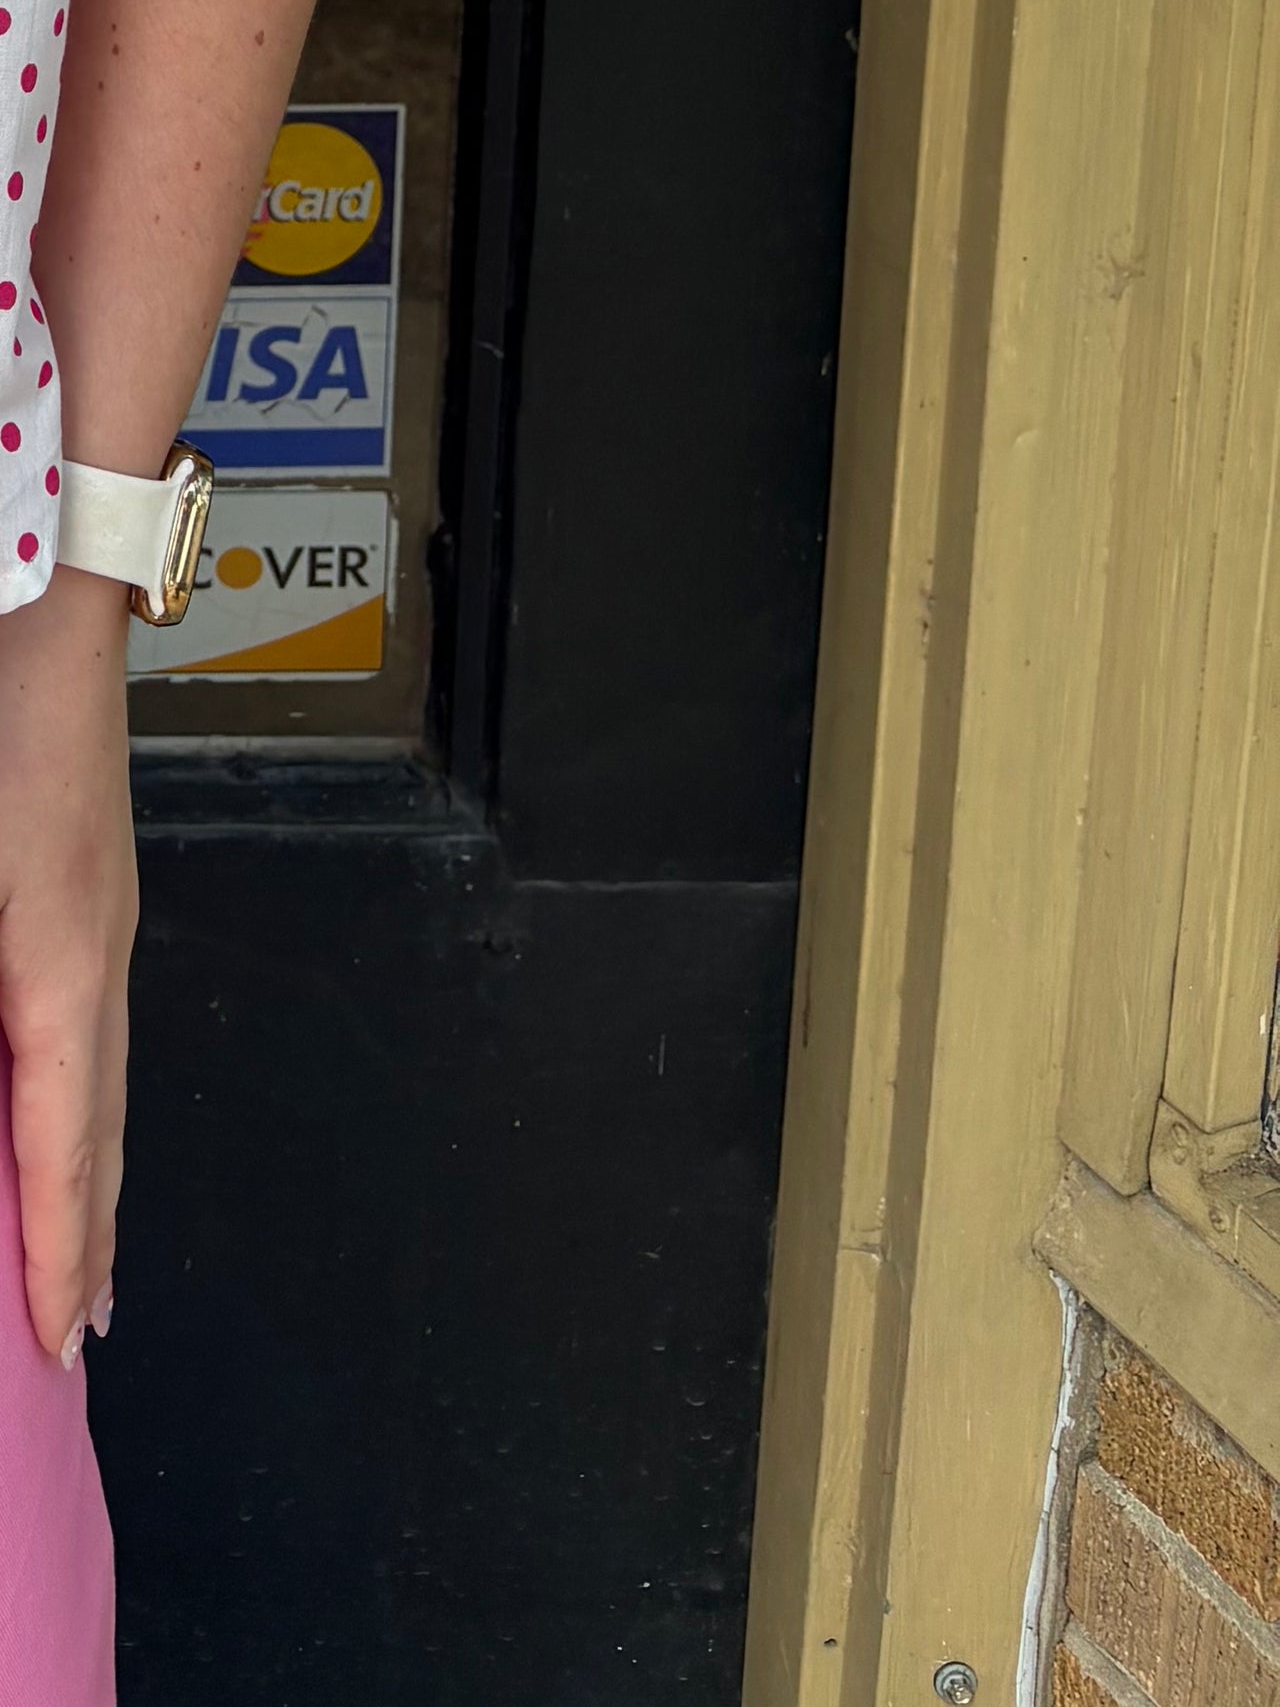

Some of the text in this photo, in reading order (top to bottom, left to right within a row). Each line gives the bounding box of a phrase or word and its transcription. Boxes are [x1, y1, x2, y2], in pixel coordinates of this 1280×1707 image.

[252, 179, 375, 222] rCard
[206, 325, 368, 403] ISA
[192, 545, 370, 590] COVER
